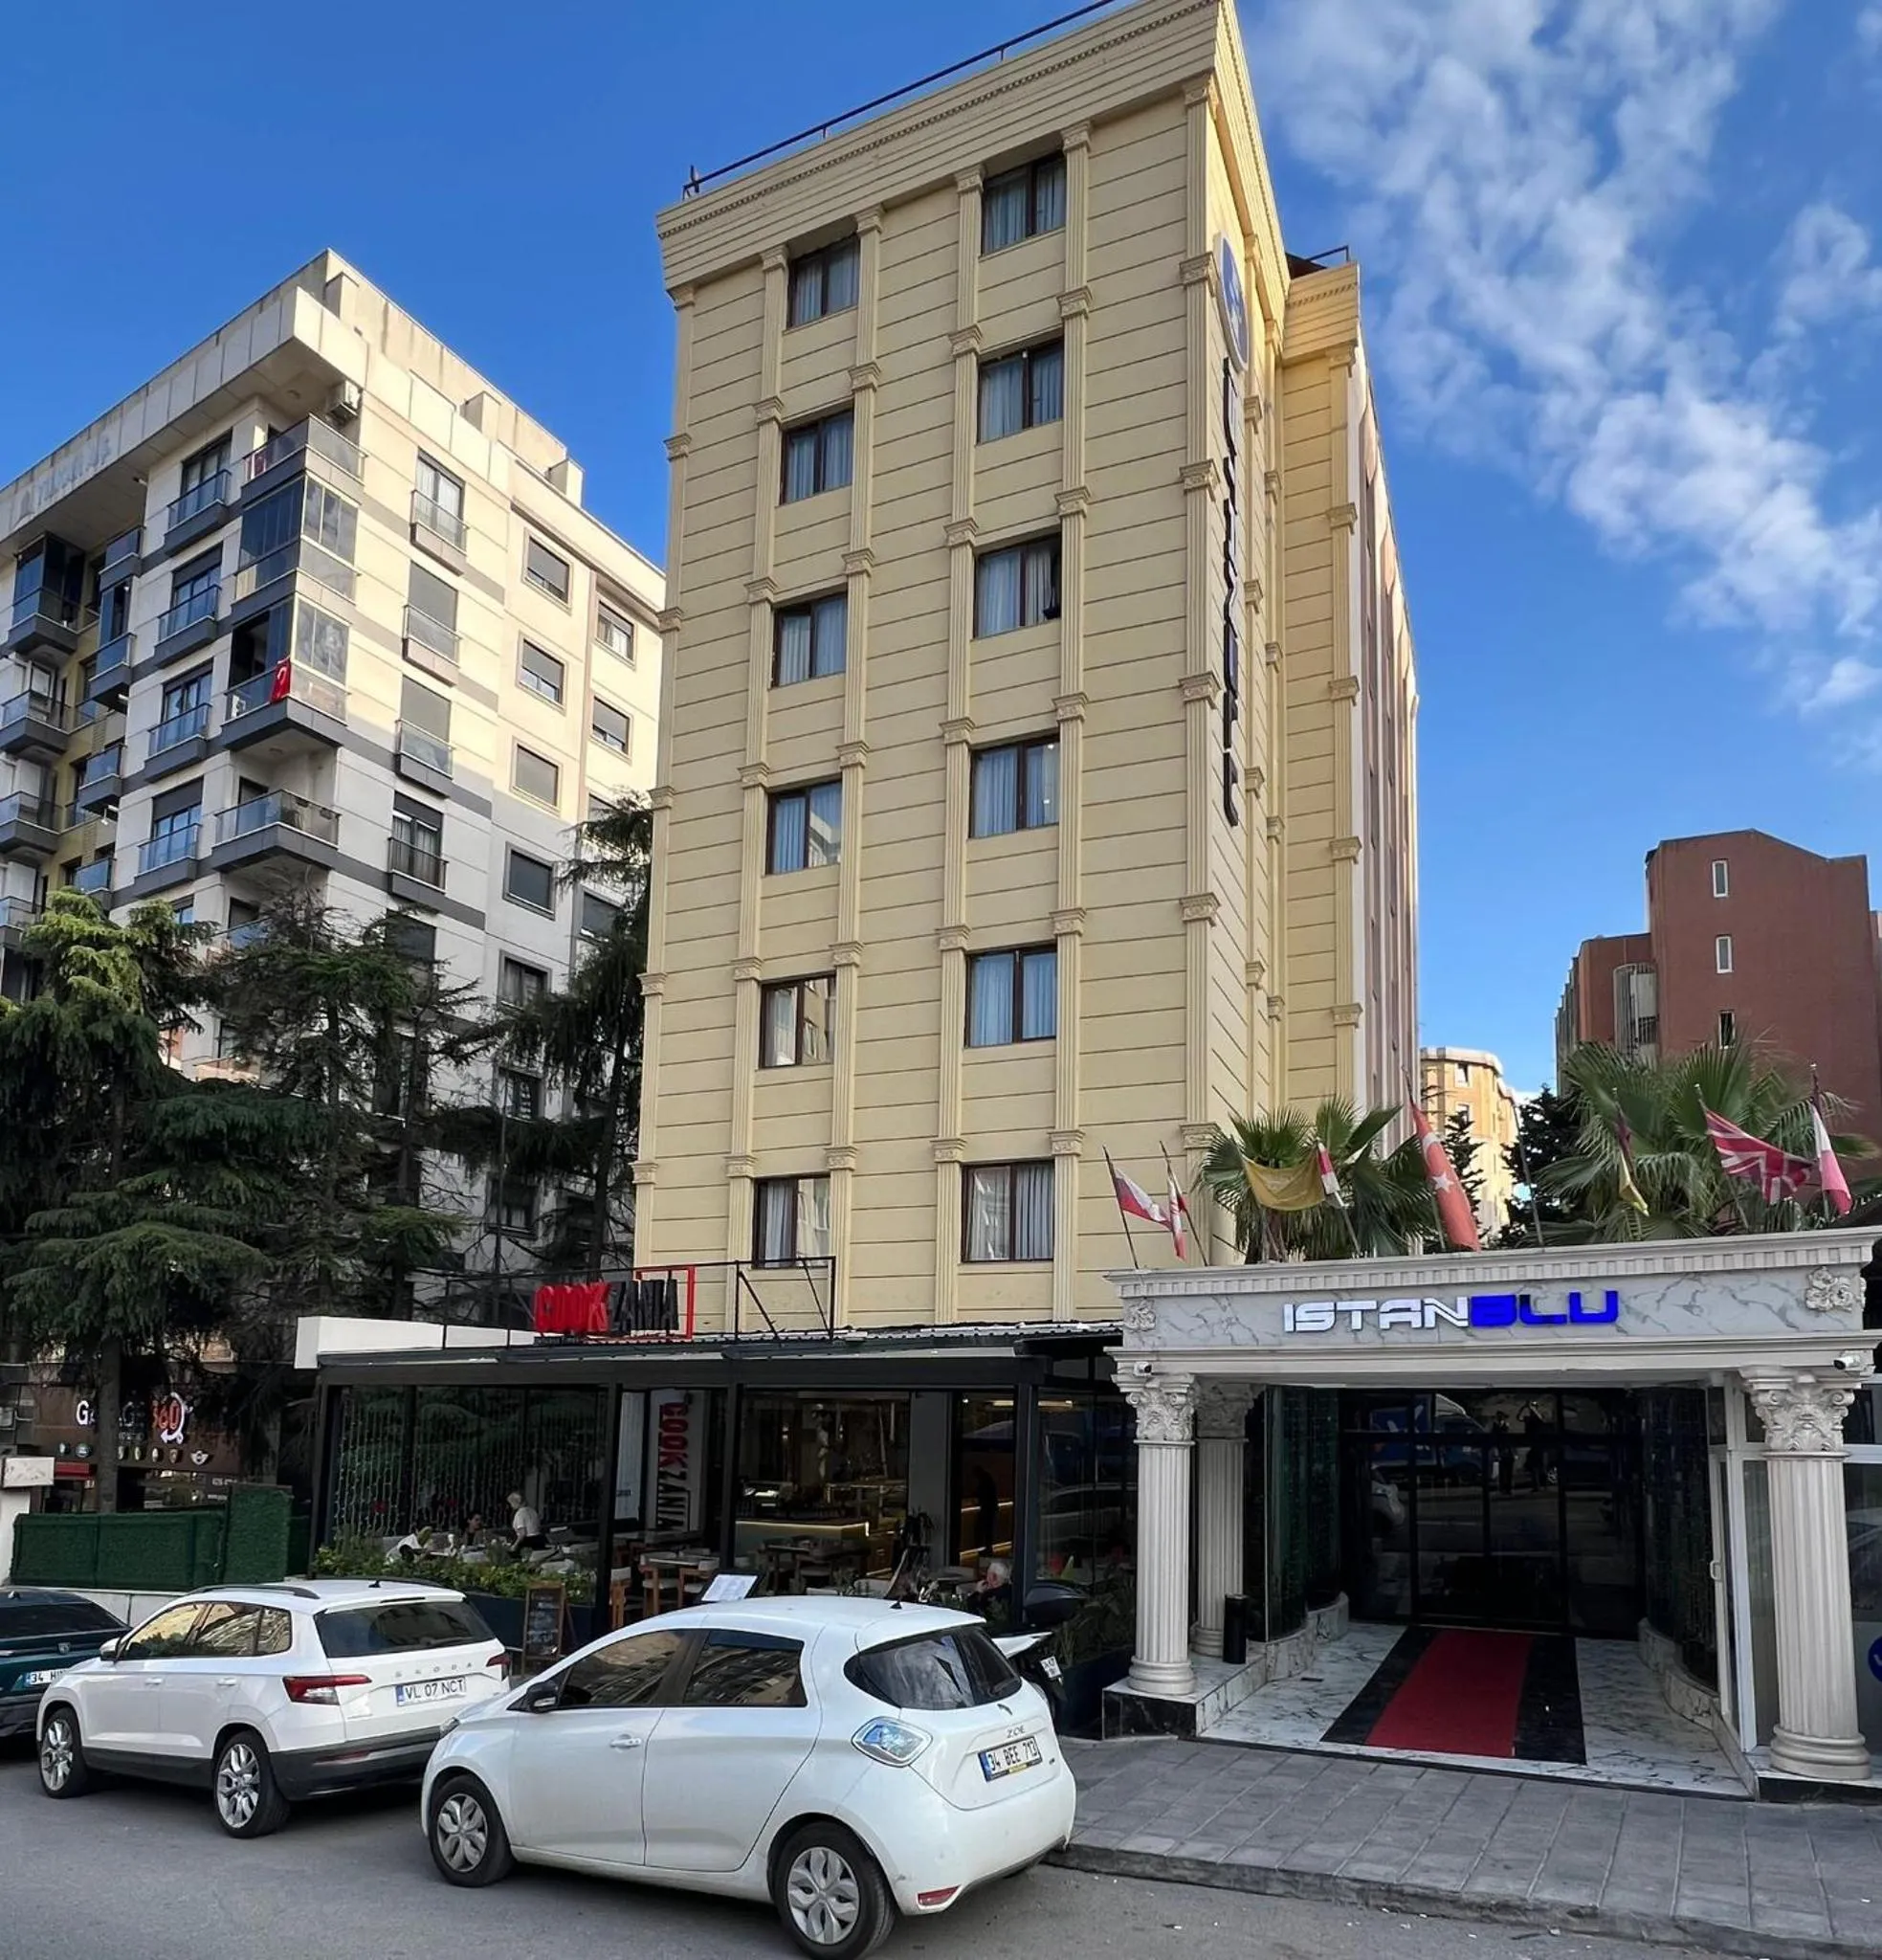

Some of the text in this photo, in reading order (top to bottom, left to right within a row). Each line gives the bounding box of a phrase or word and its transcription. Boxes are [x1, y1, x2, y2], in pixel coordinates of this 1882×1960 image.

[1284, 1290, 1619, 1332] ISTANBLU
[32, 1673, 44, 1683] 34
[405, 1680, 464, 1699] VL 07 NCT
[1007, 1726, 1026, 1738] ZOE
[987, 1752, 1002, 1771] 34
[1003, 1746, 1022, 1766] BEE
